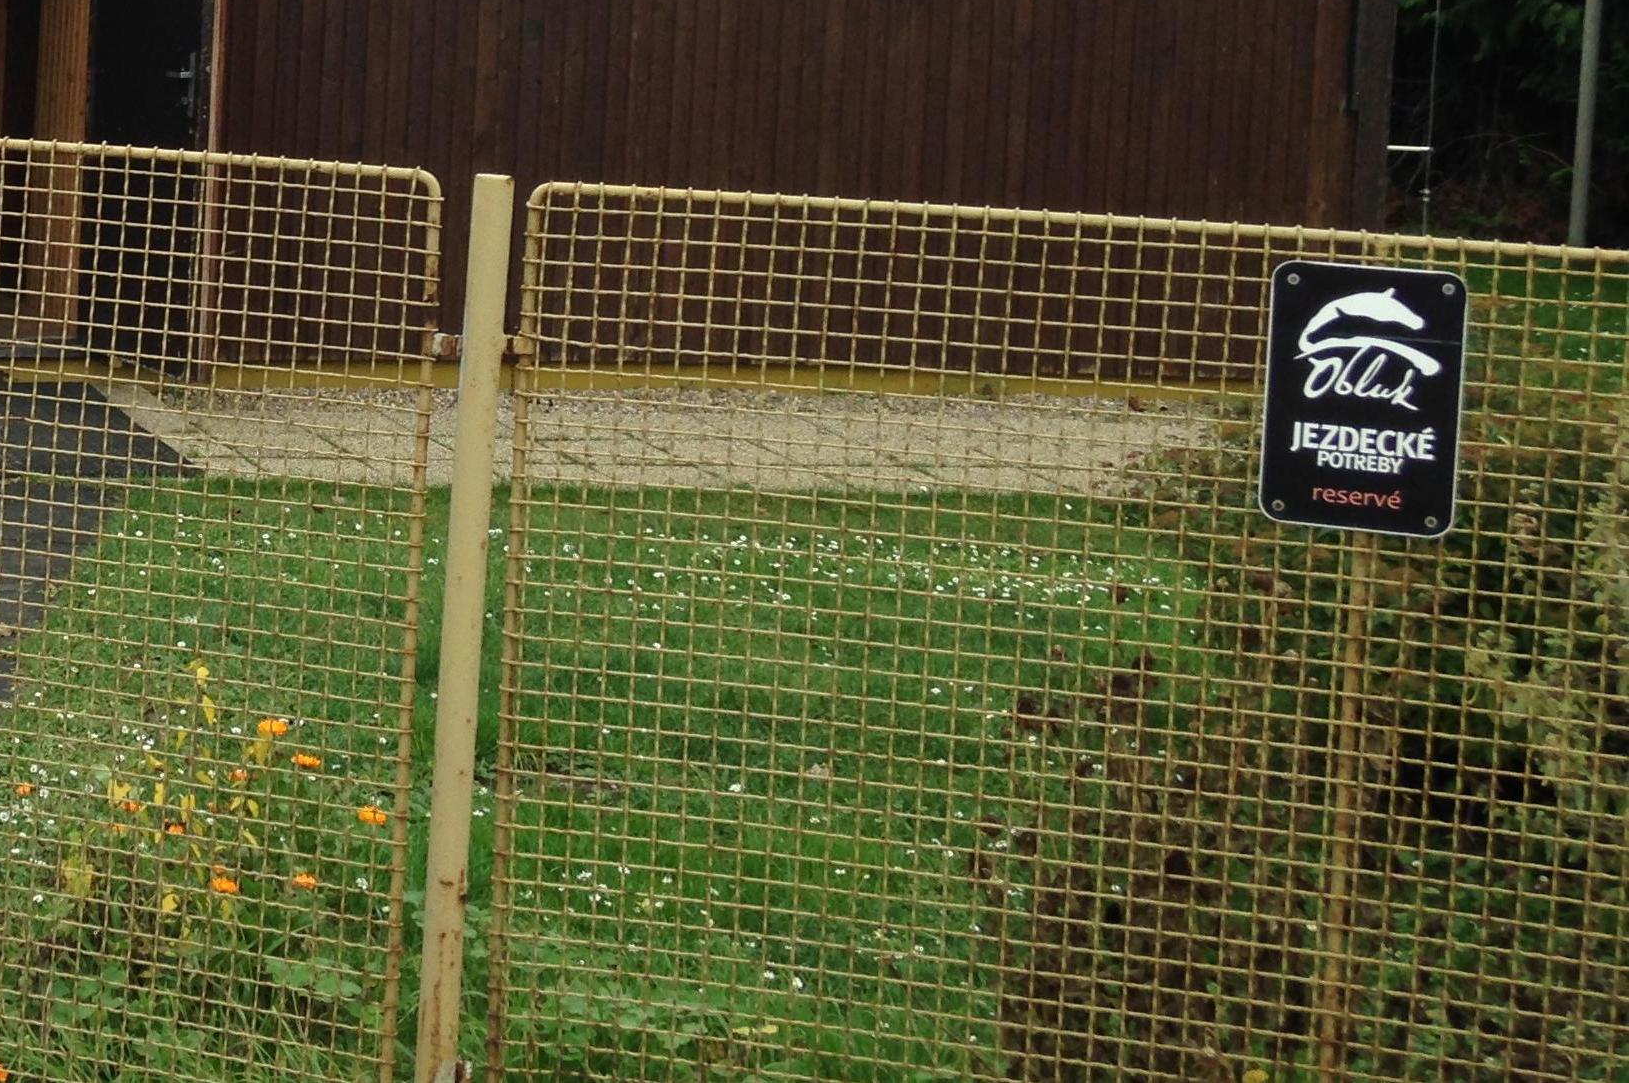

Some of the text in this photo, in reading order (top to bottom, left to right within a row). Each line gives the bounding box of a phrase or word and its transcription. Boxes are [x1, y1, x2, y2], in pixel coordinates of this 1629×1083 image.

[1303, 346, 1420, 411] Obluk
[1290, 421, 1437, 461] JEZDECKÉ
[1312, 486, 1402, 510] reservé
